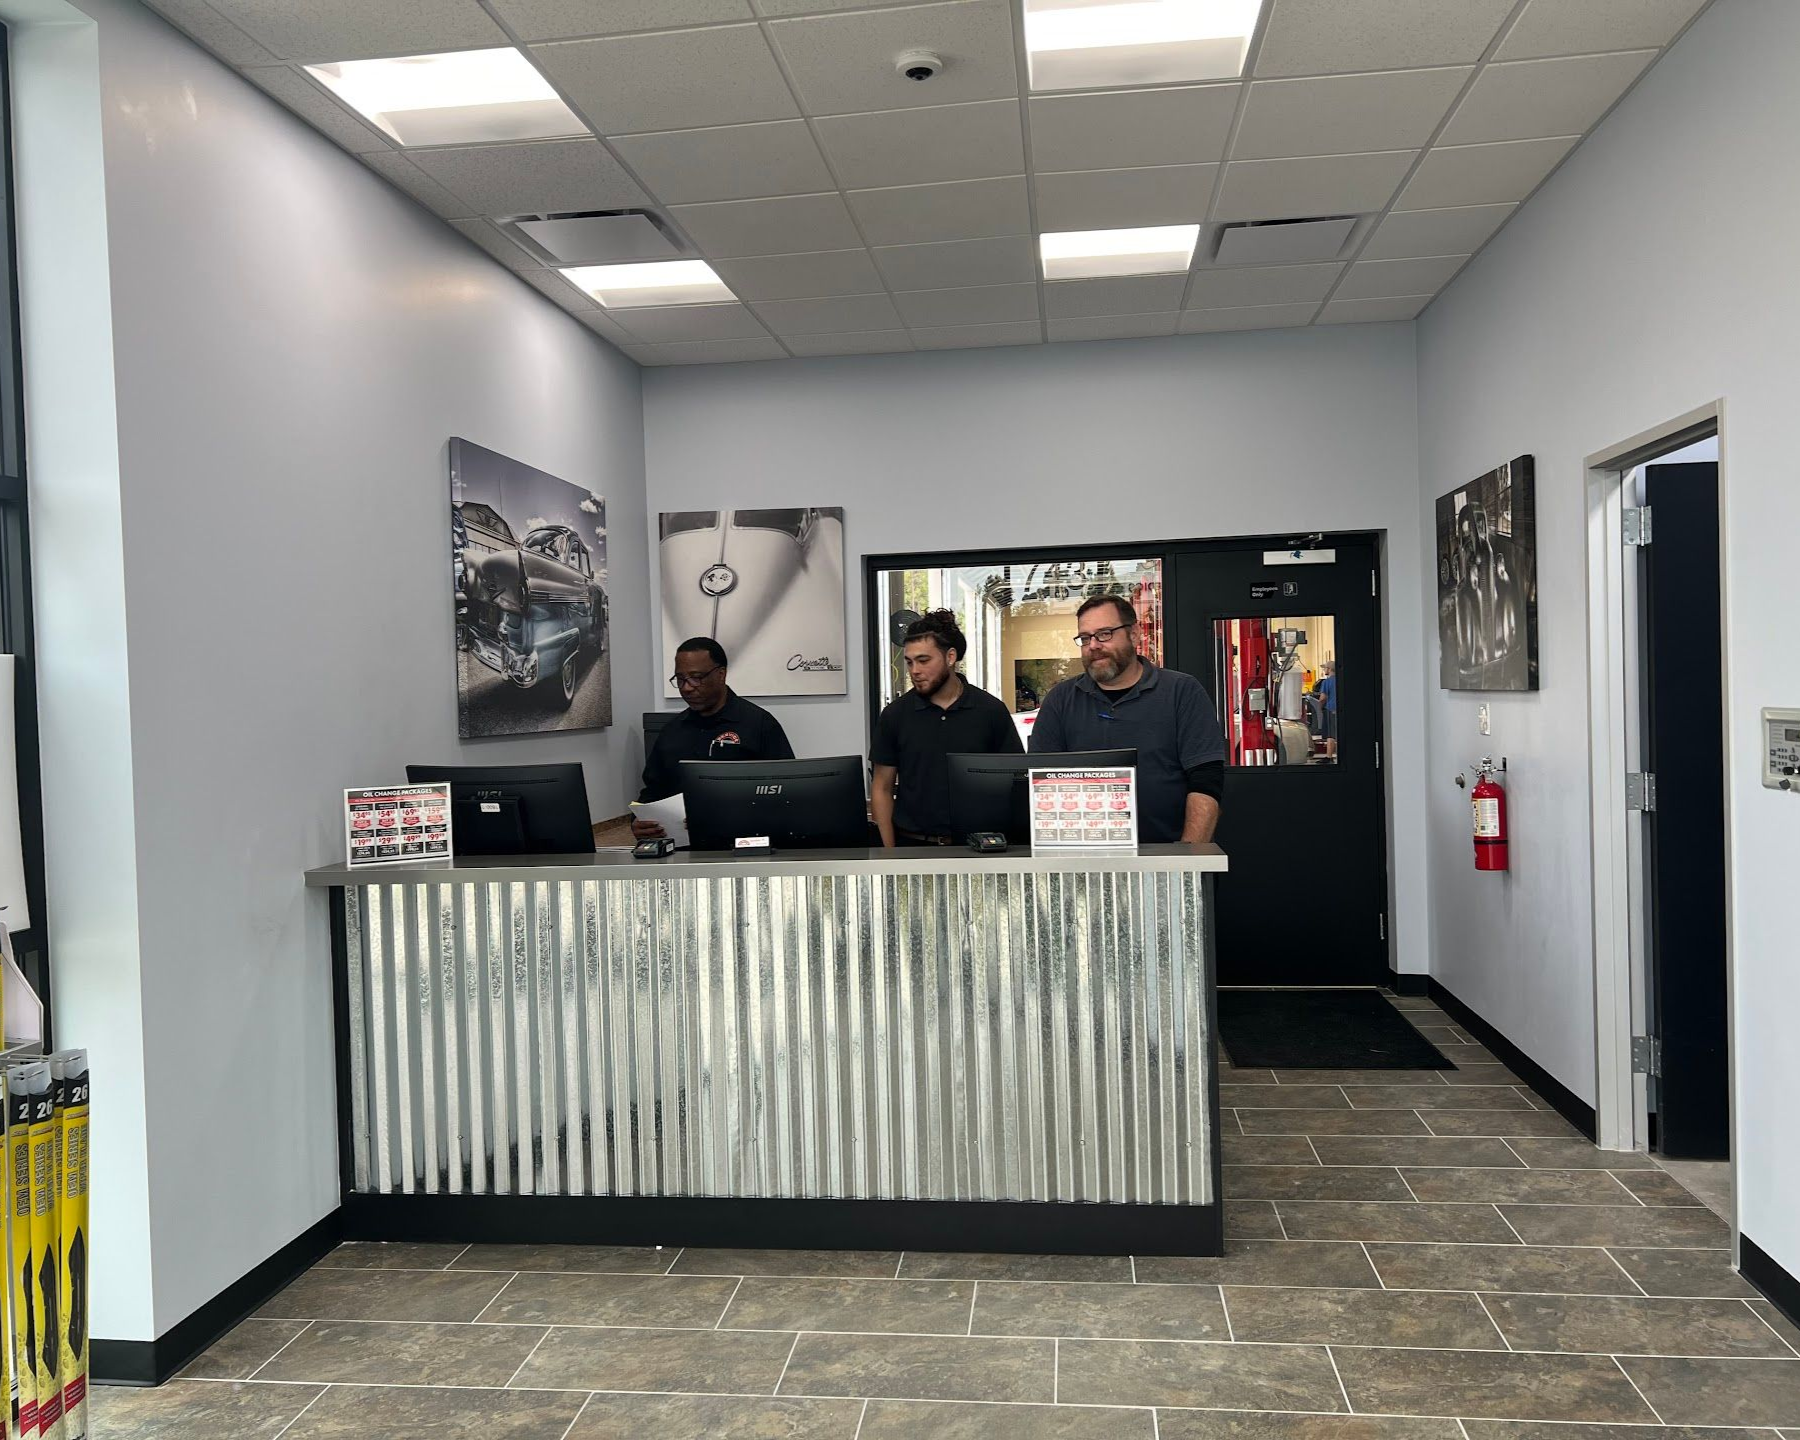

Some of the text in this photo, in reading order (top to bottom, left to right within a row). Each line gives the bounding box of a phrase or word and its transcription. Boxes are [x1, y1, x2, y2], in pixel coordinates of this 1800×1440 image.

[787, 654, 829, 671] Corvette
[401, 788, 432, 796] PACKAGES
[71, 1084, 88, 1103] 26
[37, 1099, 53, 1120] 26
[67, 1127, 79, 1169] SERIES
[15, 1143, 29, 1187] SERIES
[34, 1142, 46, 1187] SERIES
[67, 1170, 78, 1199] OEM
[17, 1187, 30, 1217] OEM
[35, 1187, 46, 1217] OEM
